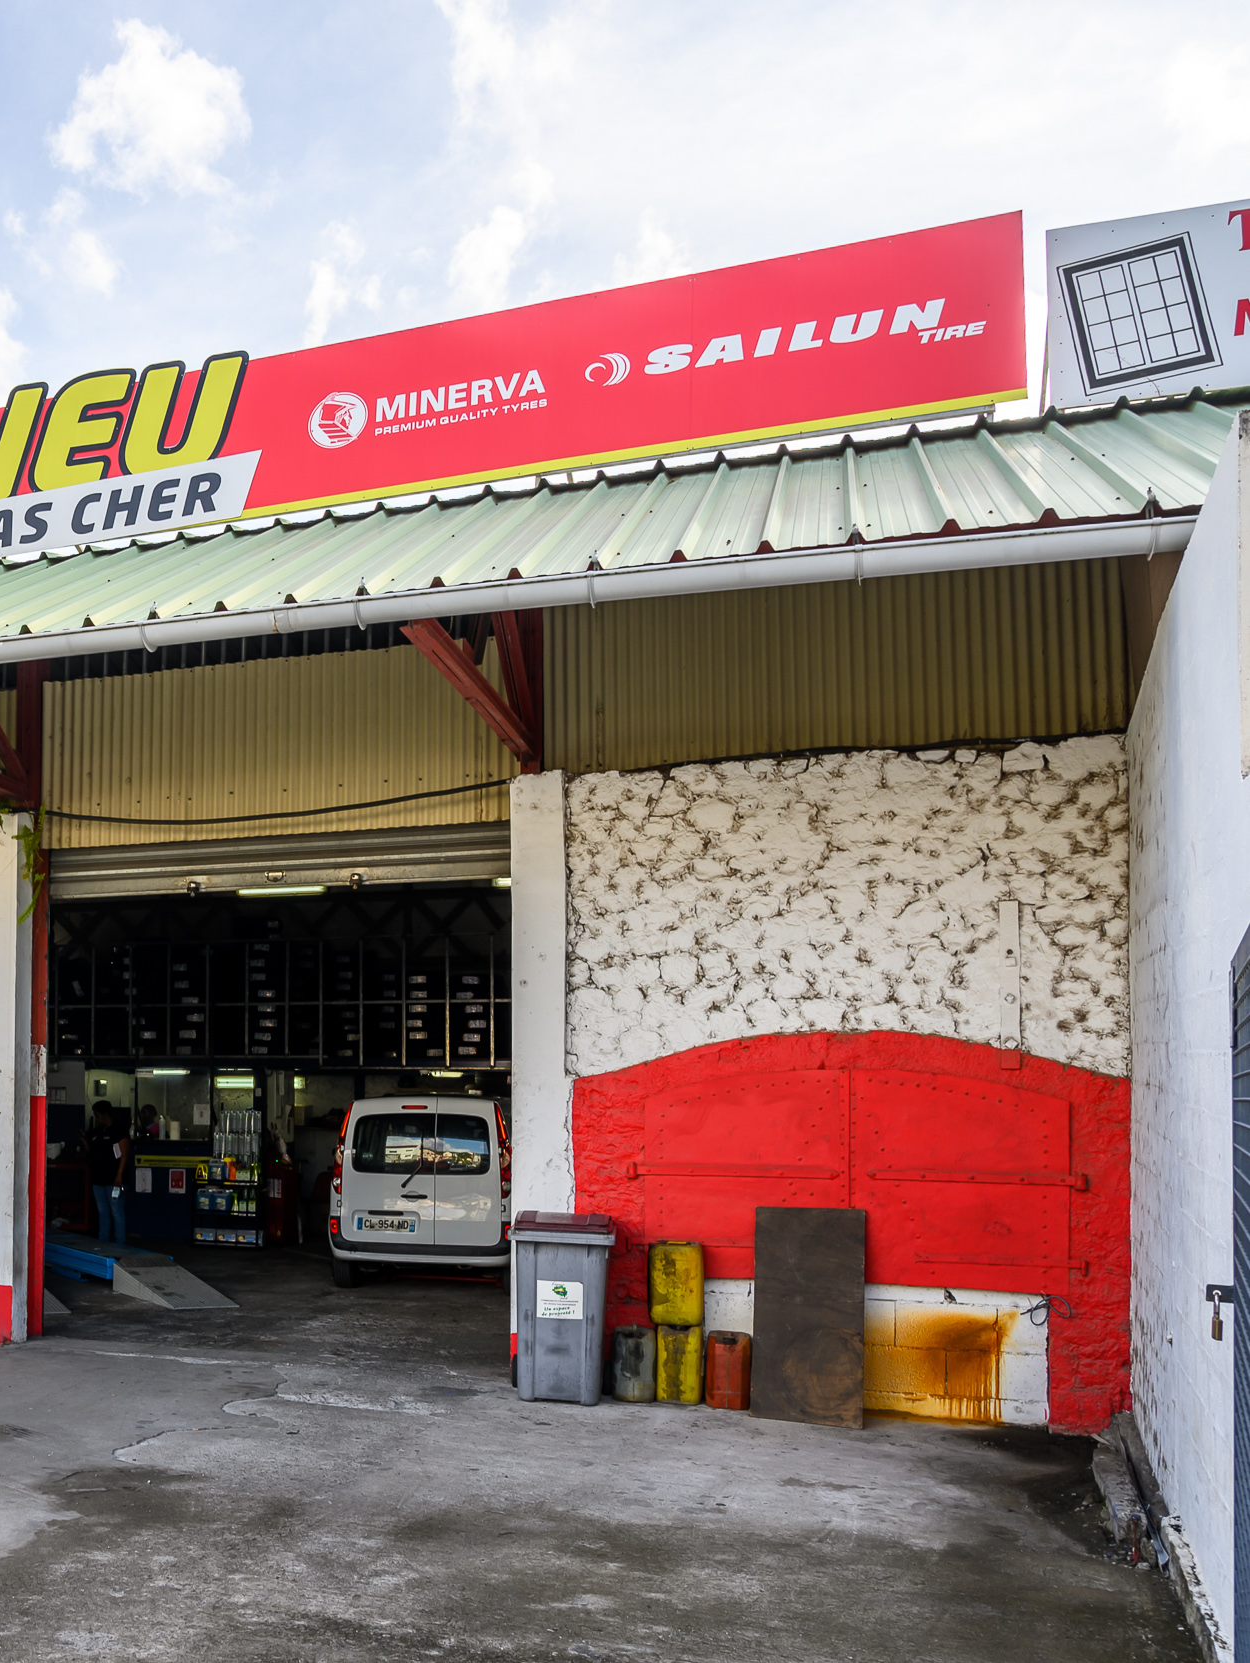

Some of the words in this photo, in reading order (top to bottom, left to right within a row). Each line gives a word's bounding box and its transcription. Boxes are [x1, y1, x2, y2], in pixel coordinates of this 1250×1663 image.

[643, 297, 946, 375] SAILUN
[917, 320, 987, 345] TIRE
[374, 418, 437, 437] PREMIUM
[439, 407, 499, 425] QUALITY
[502, 398, 548, 414] TYRES
[375, 369, 546, 423] MINERVA
[70, 472, 222, 535] CHER
